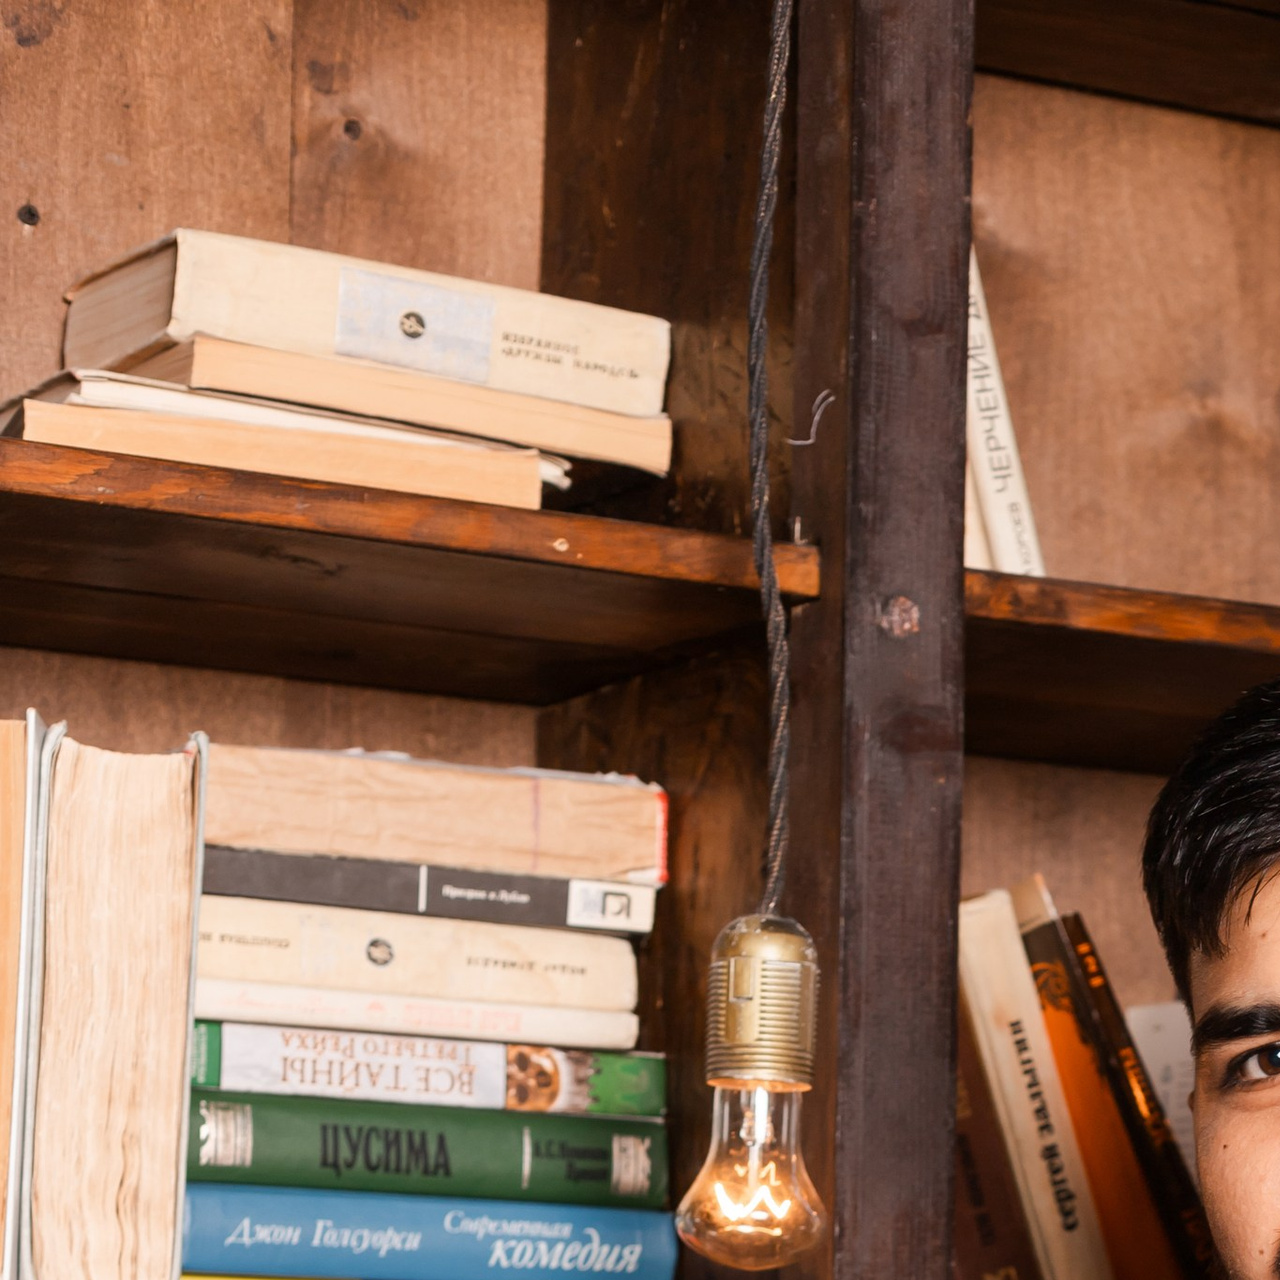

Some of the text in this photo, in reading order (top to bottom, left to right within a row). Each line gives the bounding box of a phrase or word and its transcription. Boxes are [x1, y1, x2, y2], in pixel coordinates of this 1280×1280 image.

[968, 331, 1013, 494] ЧЕРЧЕНИЕ
[280, 1030, 472, 1063] ТРЕТЬЕГО РЕЙХА
[280, 1055, 476, 1096] ВСЕ ТАЙНЫ
[319, 1123, 452, 1178] ЦУСИМА
[223, 1216, 302, 1248] Джон
